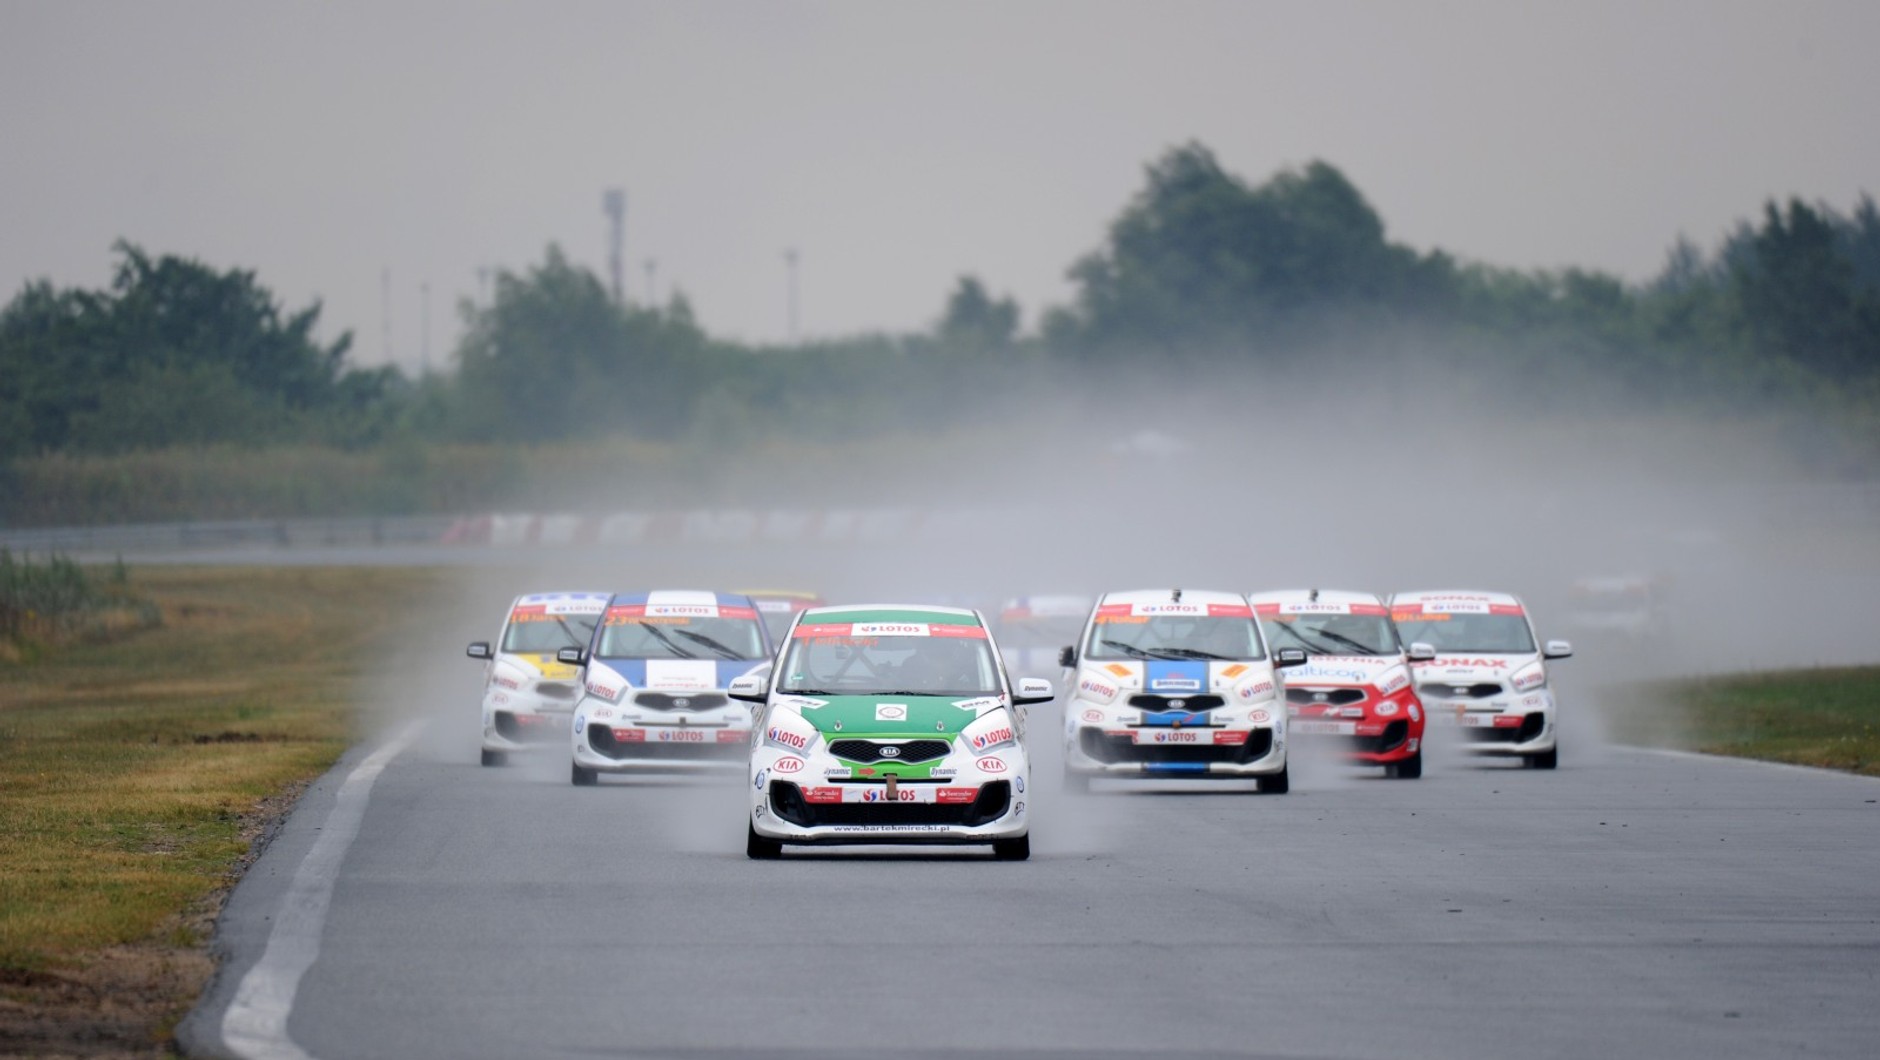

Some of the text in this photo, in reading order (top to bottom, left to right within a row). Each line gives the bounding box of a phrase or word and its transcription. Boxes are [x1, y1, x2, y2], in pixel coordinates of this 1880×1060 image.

[594, 684, 616, 698] LOTOS
[1090, 683, 1114, 698] LOTOS
[1252, 681, 1273, 695] LOTOS
[672, 732, 704, 741] LOTOS
[778, 730, 806, 748] LOTOS
[985, 728, 1012, 744] LOTOS
[1167, 733, 1197, 742] LOTOS
[824, 768, 851, 776] Dynamic
[931, 767, 957, 777] Dynamic
[880, 789, 915, 801] LOS
